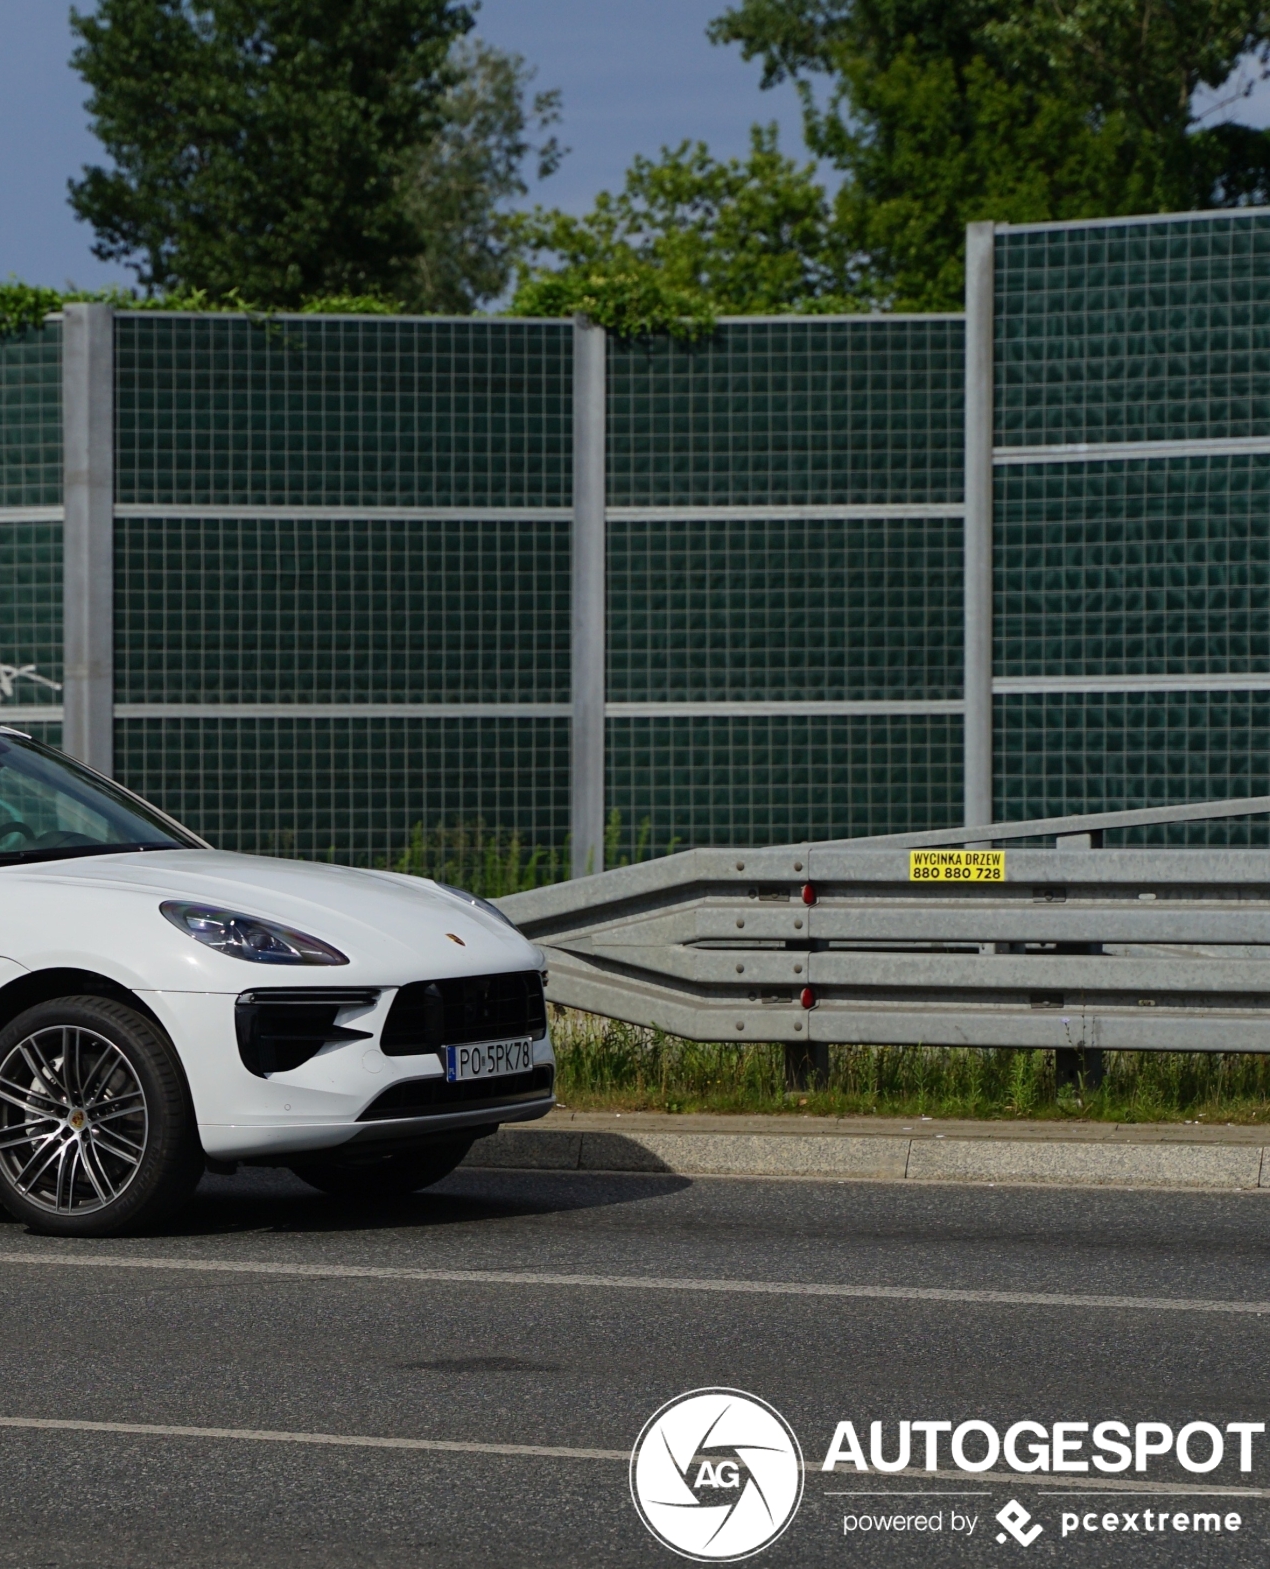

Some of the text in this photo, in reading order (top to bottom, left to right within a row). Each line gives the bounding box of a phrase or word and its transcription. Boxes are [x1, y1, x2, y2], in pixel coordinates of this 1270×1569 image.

[914, 853, 1001, 866] WYCINKA DRZEW
[913, 867, 1001, 880] 880 880 728
[487, 1041, 530, 1073] 5PK78
